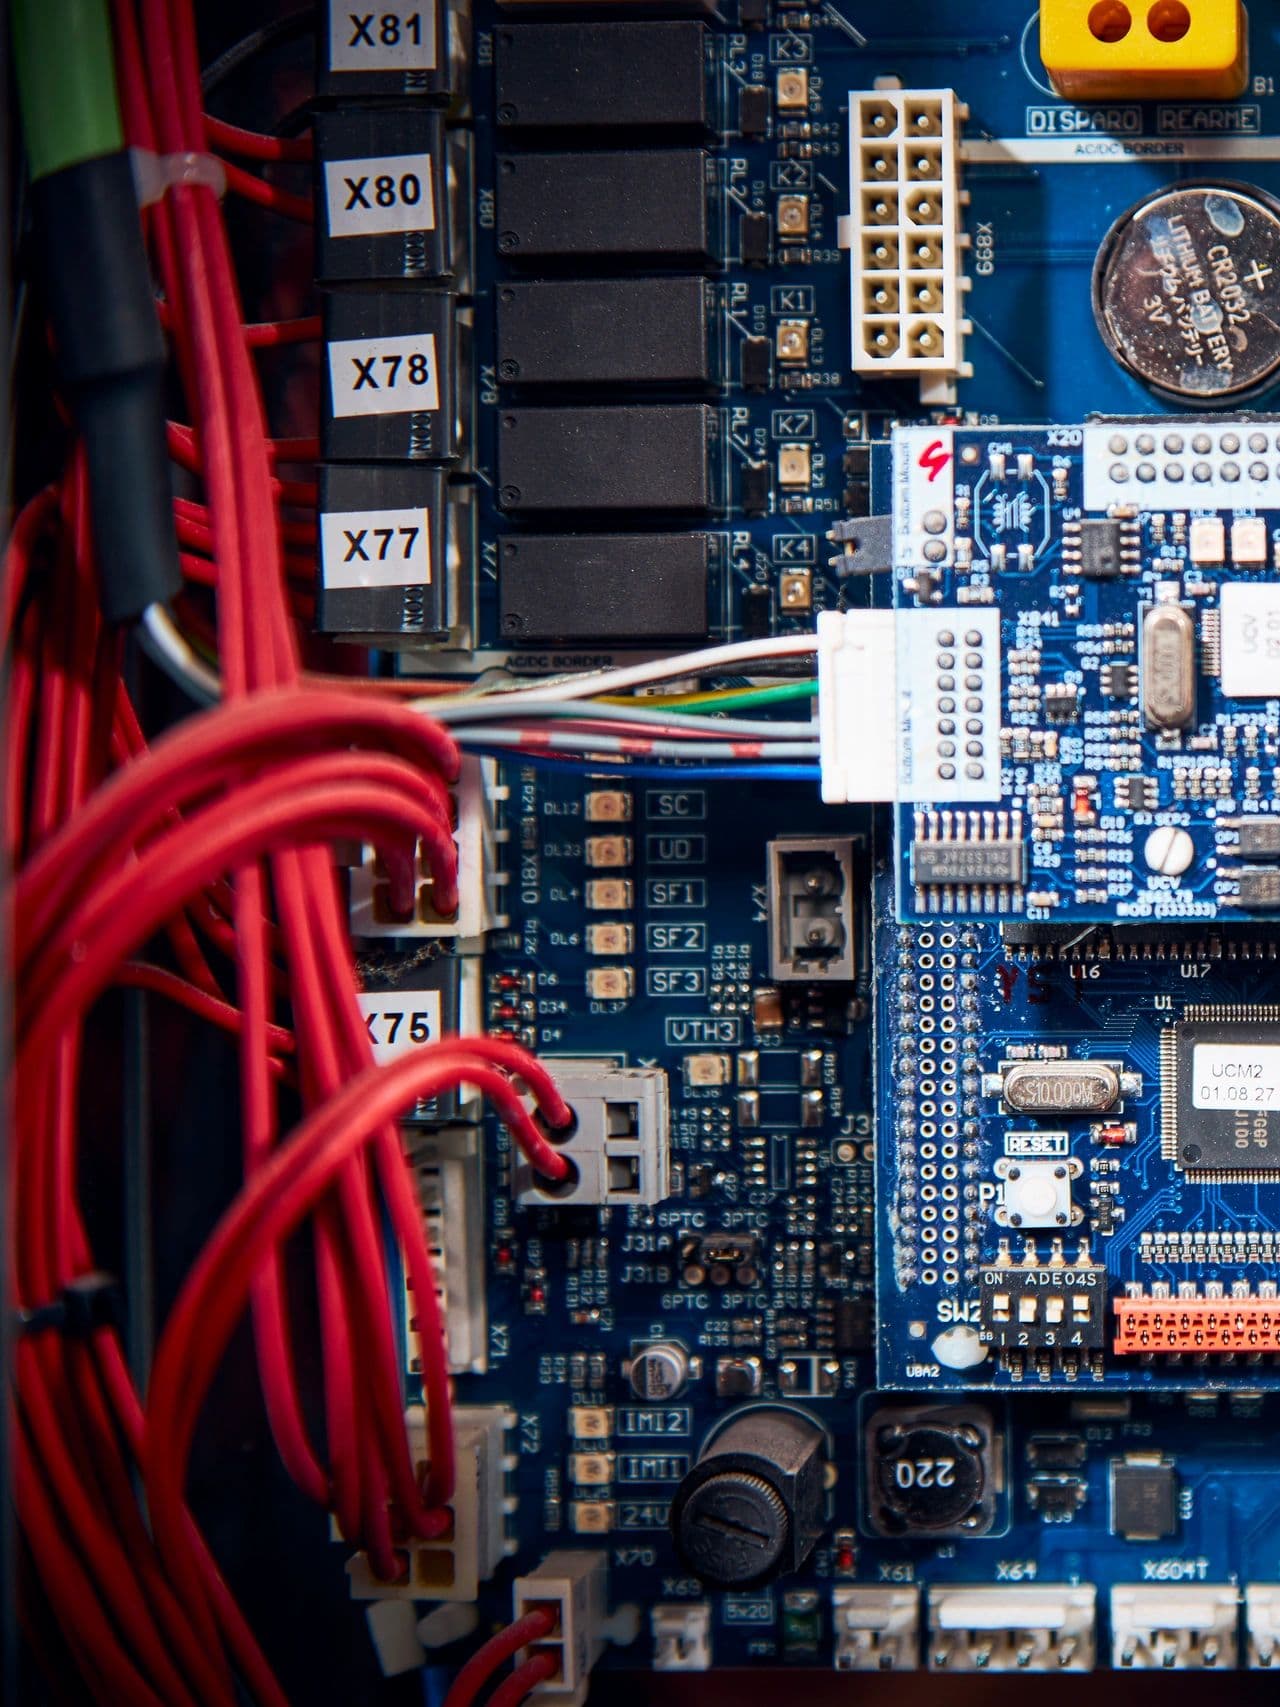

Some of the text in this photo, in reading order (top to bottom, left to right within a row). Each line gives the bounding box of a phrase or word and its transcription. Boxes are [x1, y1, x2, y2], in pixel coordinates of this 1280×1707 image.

[348, 13, 422, 47] X81
[729, 33, 748, 75] RL3
[776, 39, 809, 58] K3
[1253, 77, 1275, 95] B1
[1031, 108, 1139, 133] DISPARO
[1162, 107, 1256, 131] REARME
[1123, 142, 1184, 155] BORDER
[730, 158, 748, 199] RL2
[776, 164, 808, 185] K2
[344, 174, 420, 210] X80
[975, 222, 994, 276] X899
[1208, 245, 1251, 325] CR2032
[731, 283, 748, 318] RL1
[780, 290, 807, 310] K1
[1143, 294, 1173, 326] 3V
[811, 327, 825, 366] DL13
[352, 354, 429, 390] X78
[731, 406, 750, 447] RL7
[779, 415, 809, 435] K7
[343, 527, 420, 563] X77
[779, 540, 809, 558] K4
[658, 794, 690, 816] SC
[659, 838, 690, 860] UD
[520, 855, 540, 904] X810
[651, 881, 694, 904] SF1
[651, 927, 698, 948] SF2
[651, 971, 698, 991] SF3
[1180, 963, 1212, 979] U17
[1154, 995, 1174, 1010] U1
[671, 1025, 735, 1046] VTH3
[1211, 1064, 1264, 1079] UCM2
[840, 1114, 870, 1136] J3
[1008, 1137, 1066, 1153] RESET
[979, 1183, 1004, 1206] P1
[658, 1211, 769, 1228] 6PTC 3PTC
[621, 1234, 672, 1252] J31A
[620, 1268, 671, 1283] J31B
[984, 1271, 1098, 1287] ON ADE04S
[661, 1292, 770, 1309] 6PTC 3PTC
[936, 1300, 981, 1323] SW2
[1018, 1331, 1030, 1345] 2
[1045, 1331, 1057, 1345] 3
[1070, 1331, 1084, 1345] 4
[905, 1364, 941, 1378] UBA2
[521, 1414, 540, 1453] X72
[896, 1457, 955, 1489] 220
[615, 1550, 656, 1566] X70
[996, 1558, 1037, 1580] X64
